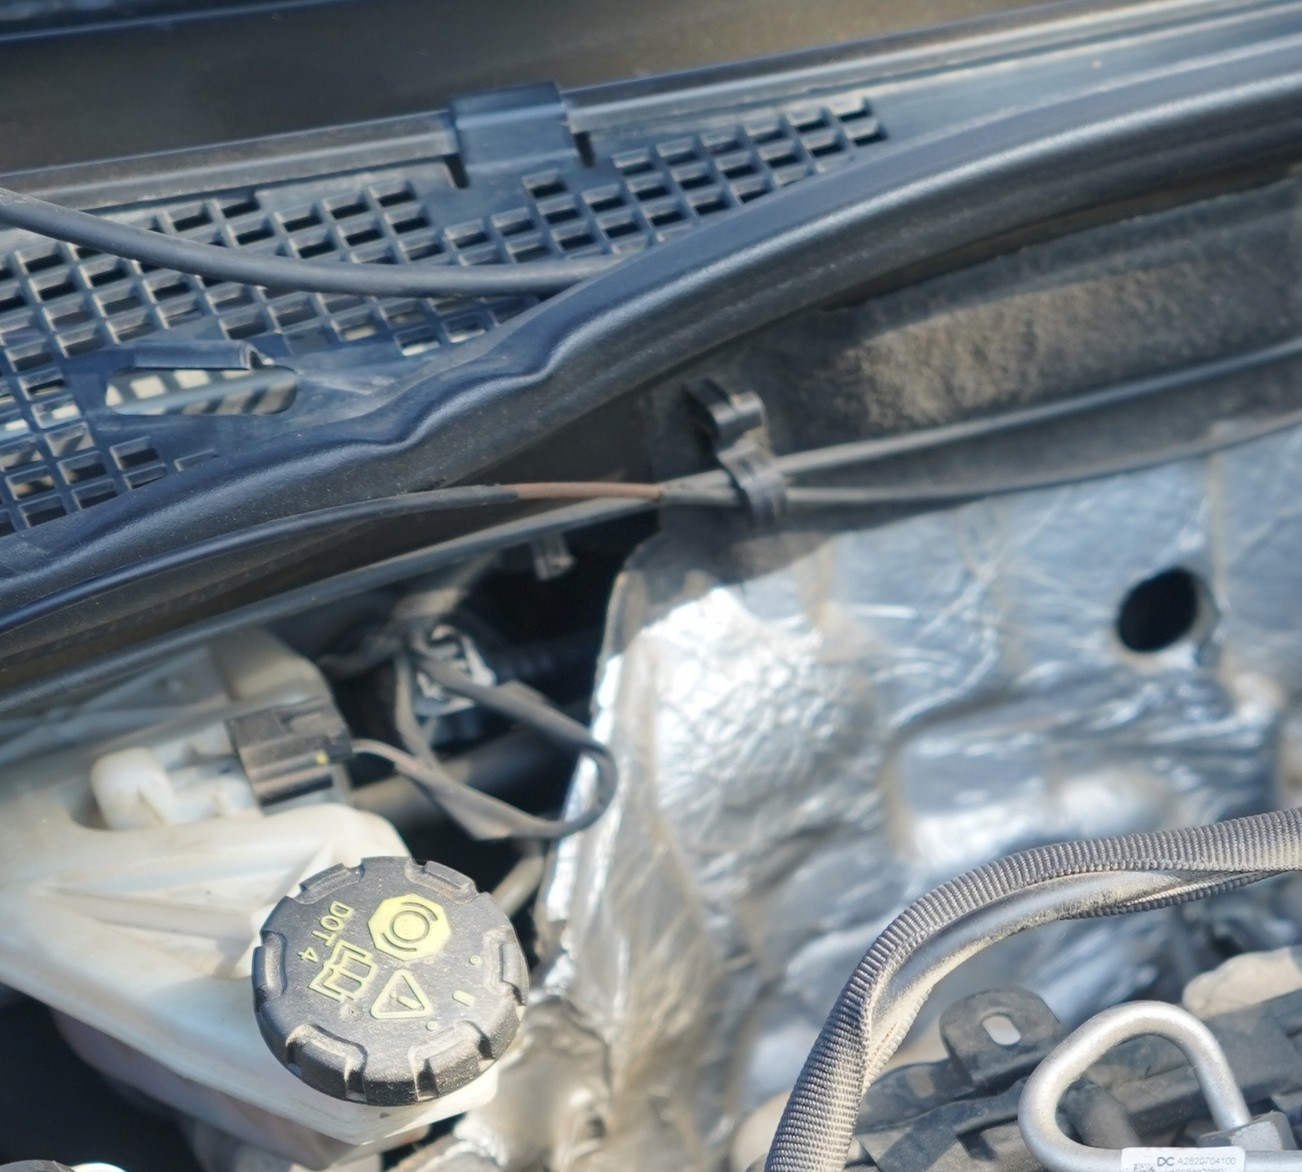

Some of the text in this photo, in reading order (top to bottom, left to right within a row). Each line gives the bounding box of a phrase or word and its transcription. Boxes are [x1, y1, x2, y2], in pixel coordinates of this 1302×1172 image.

[297, 900, 354, 964] DOT 4
[1157, 1156, 1175, 1167] DC
